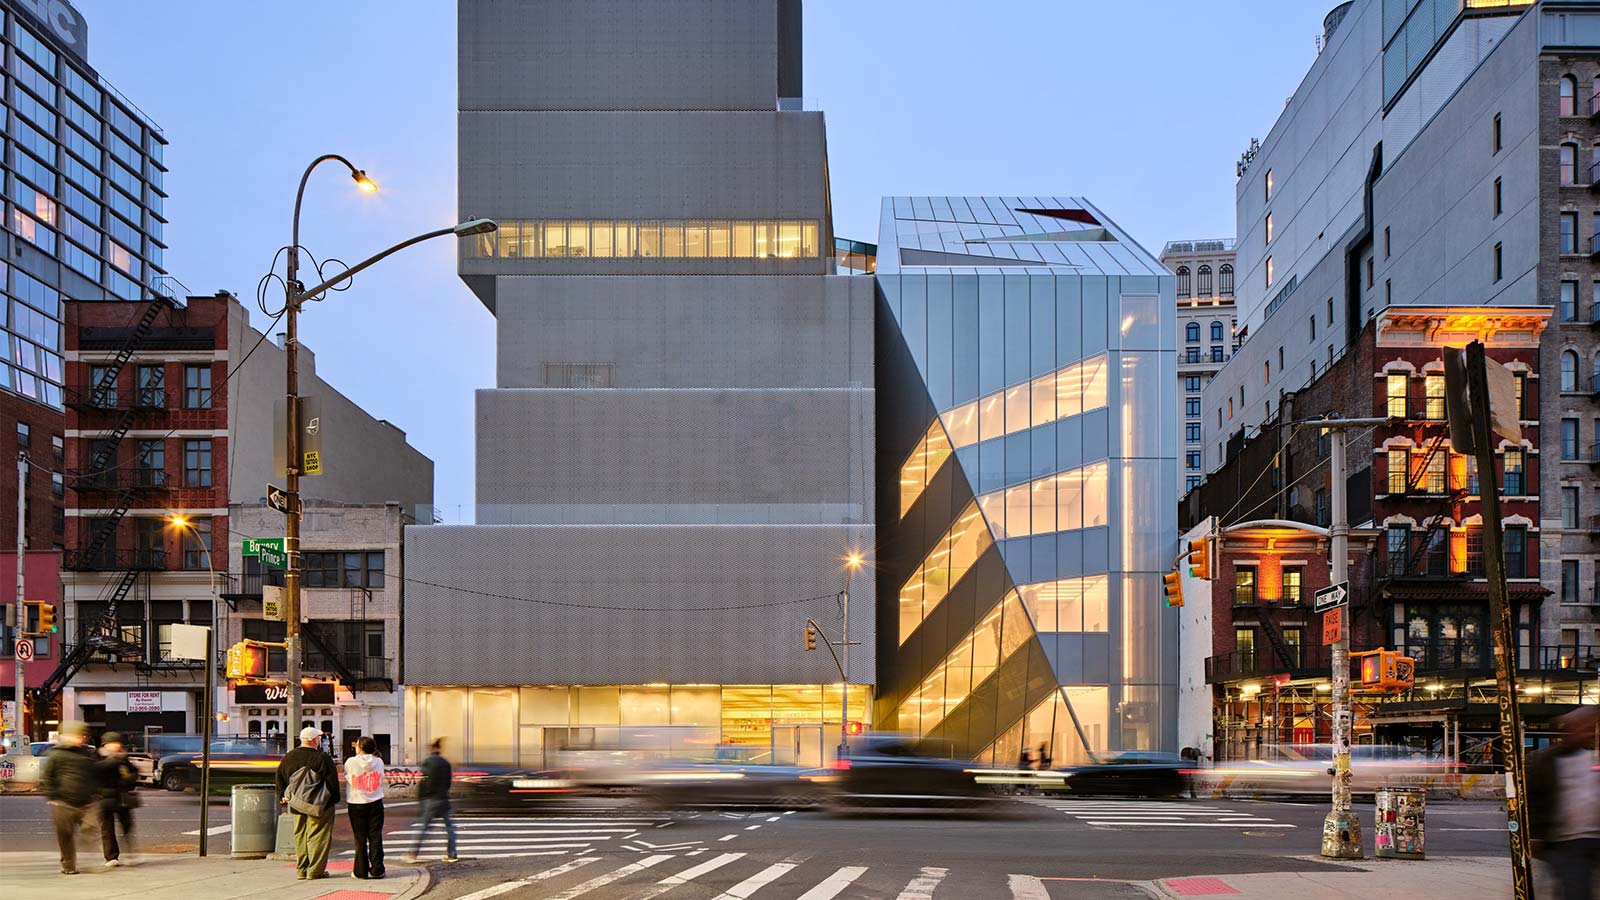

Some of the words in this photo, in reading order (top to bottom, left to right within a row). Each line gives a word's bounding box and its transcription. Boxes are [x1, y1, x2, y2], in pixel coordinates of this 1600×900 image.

[261, 548, 281, 566] Prince
[1318, 594, 1328, 605] ONE
[1331, 589, 1343, 600] WAY
[1325, 612, 1339, 626] RAISE
[1325, 628, 1339, 641] PLOW
